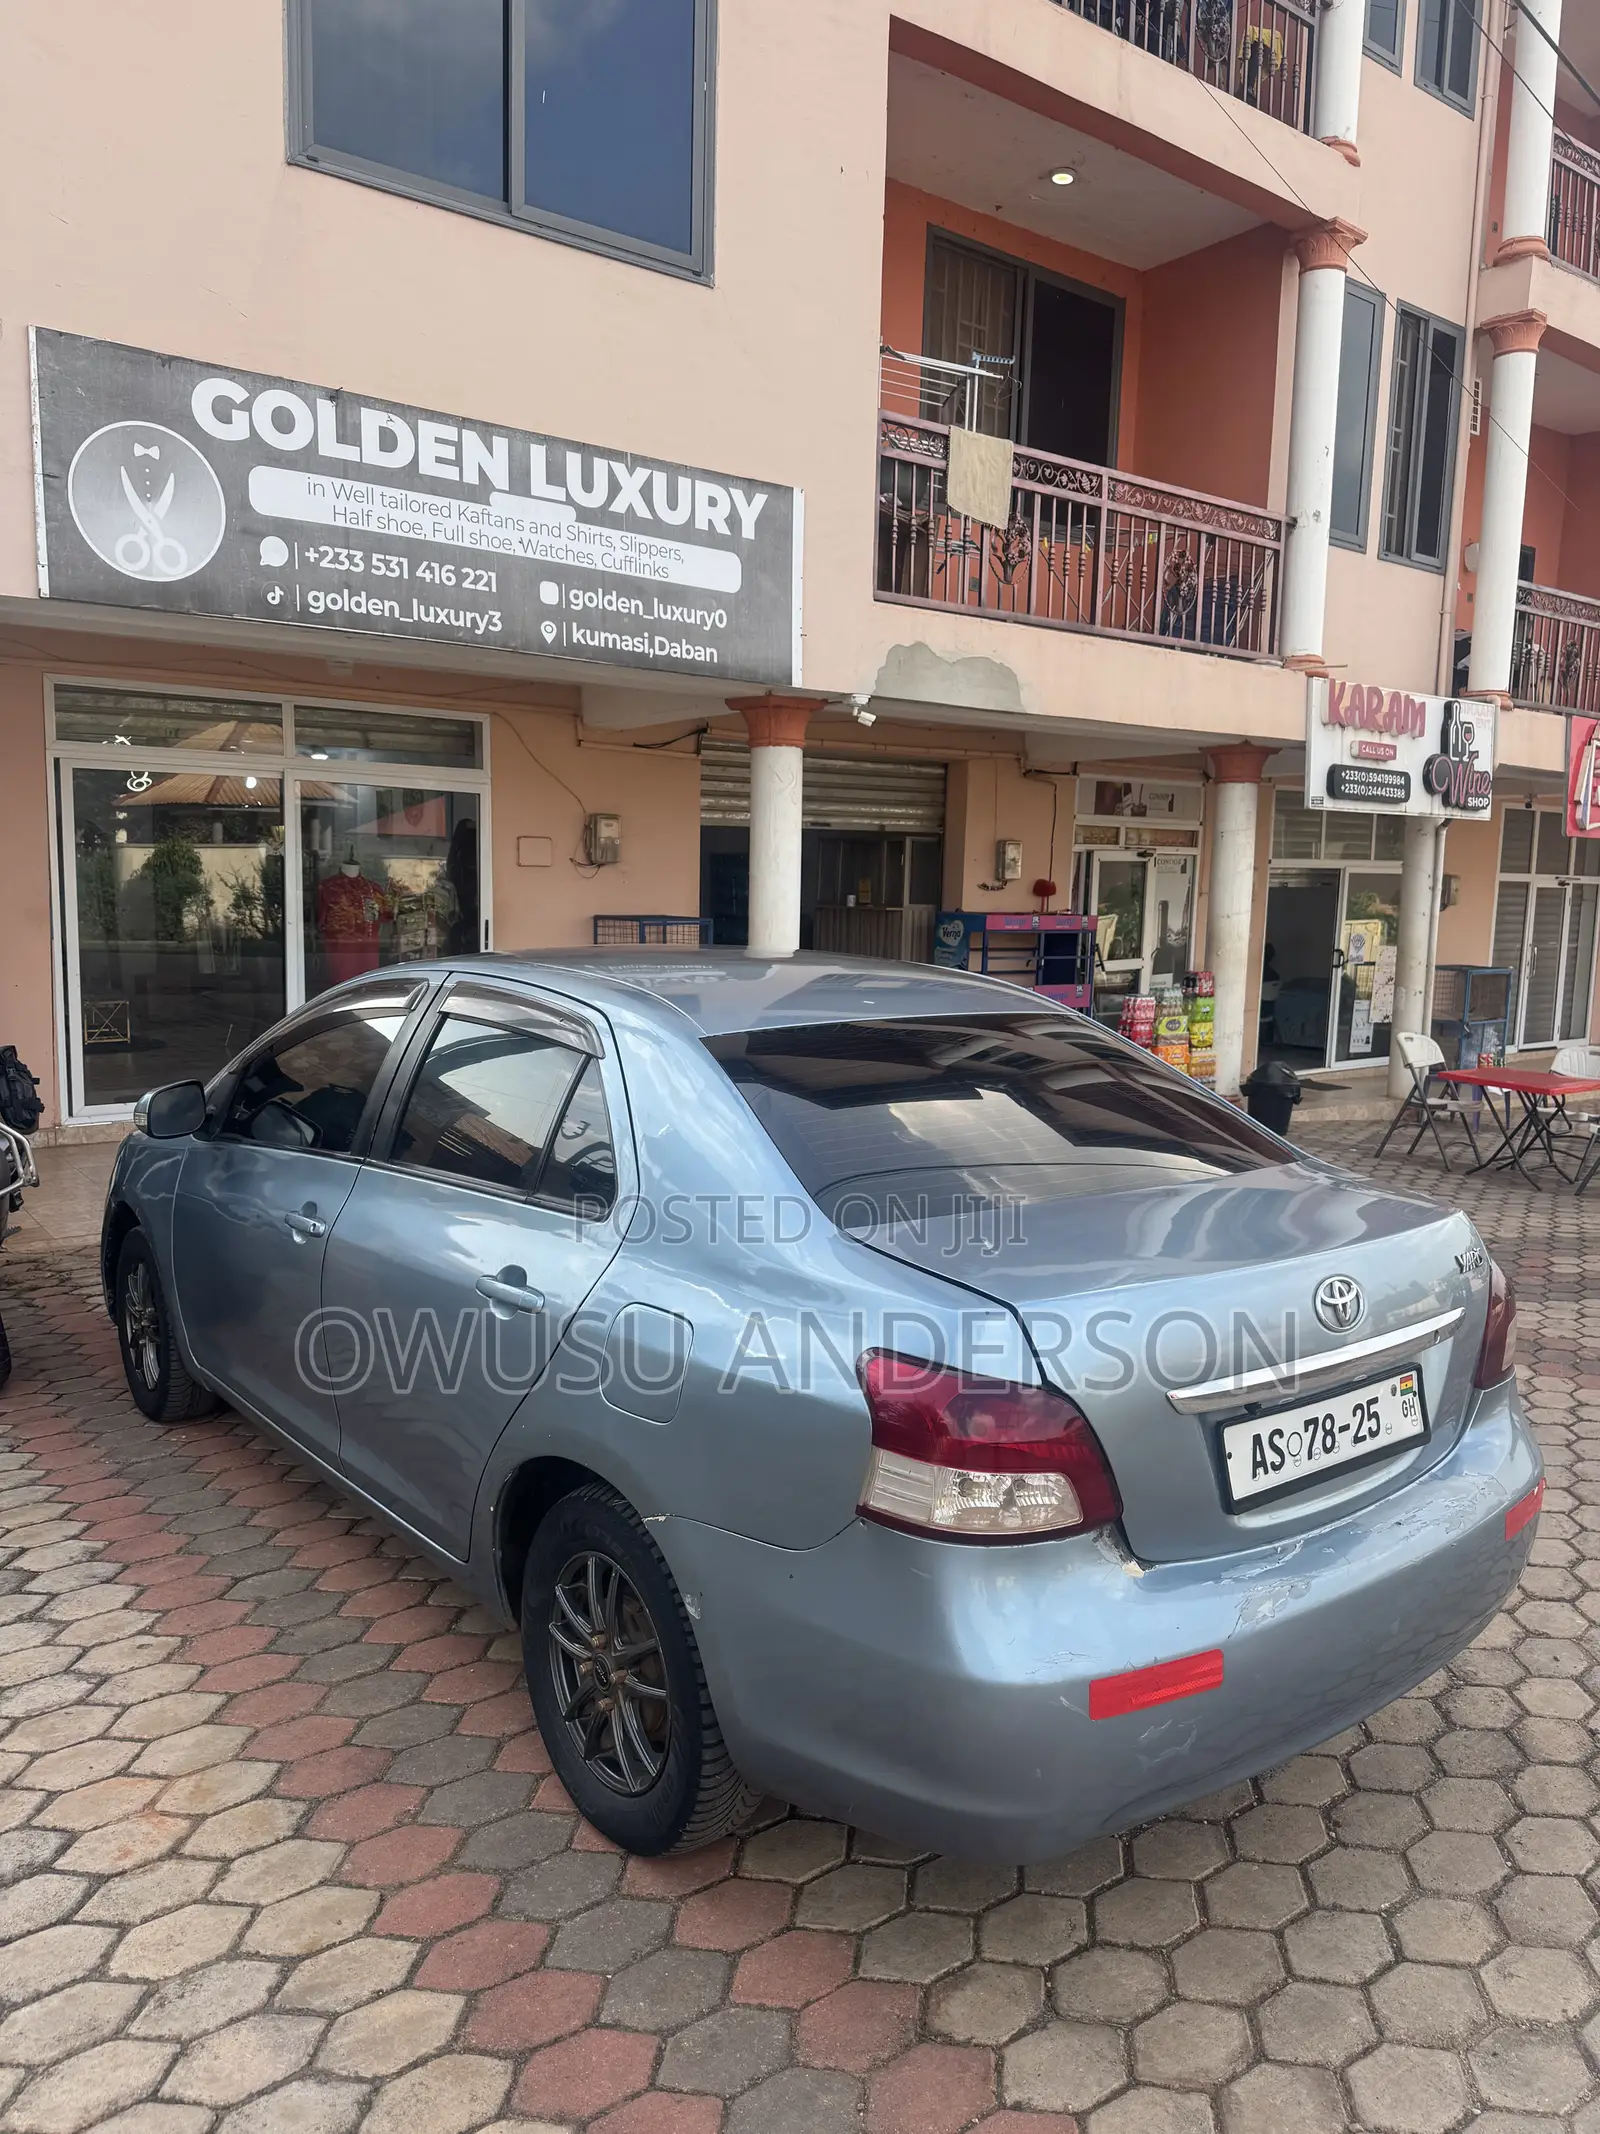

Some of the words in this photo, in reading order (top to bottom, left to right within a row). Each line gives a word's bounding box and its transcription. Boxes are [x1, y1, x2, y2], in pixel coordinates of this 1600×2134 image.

[190, 377, 510, 491] GOLDEN
[530, 443, 769, 540] LUXURY
[307, 476, 326, 498] in
[331, 481, 375, 506] Well
[379, 491, 452, 519] tailored
[457, 504, 525, 532] Kaftans
[529, 521, 562, 539] and
[566, 524, 616, 552] Shirts,
[620, 535, 684, 564] Slippers,
[333, 505, 373, 528] Half
[376, 513, 427, 540] shoe,
[432, 521, 464, 544] Full
[469, 529, 516, 554] shoe,
[518, 537, 597, 568] Watches,
[601, 553, 669, 579] Cufflinks
[304, 545, 365, 574] +233
[371, 552, 409, 580] 531
[415, 560, 457, 587] 416
[461, 567, 497, 593] 221
[307, 588, 503, 635] golden_luxury3
[569, 588, 728, 631] golden_luxury0
[572, 622, 718, 663] kumasi,Daban
[1326, 678, 1426, 738] KARAM
[1361, 744, 1376, 754] CALL
[1376, 747, 1385, 756] US
[1385, 748, 1394, 756] ON
[1432, 752, 1492, 805] Wine
[1467, 796, 1490, 808] SHOP
[1401, 1398, 1417, 1419] GH
[1252, 1428, 1286, 1480] AS
[1303, 1396, 1381, 1461] 78-25
